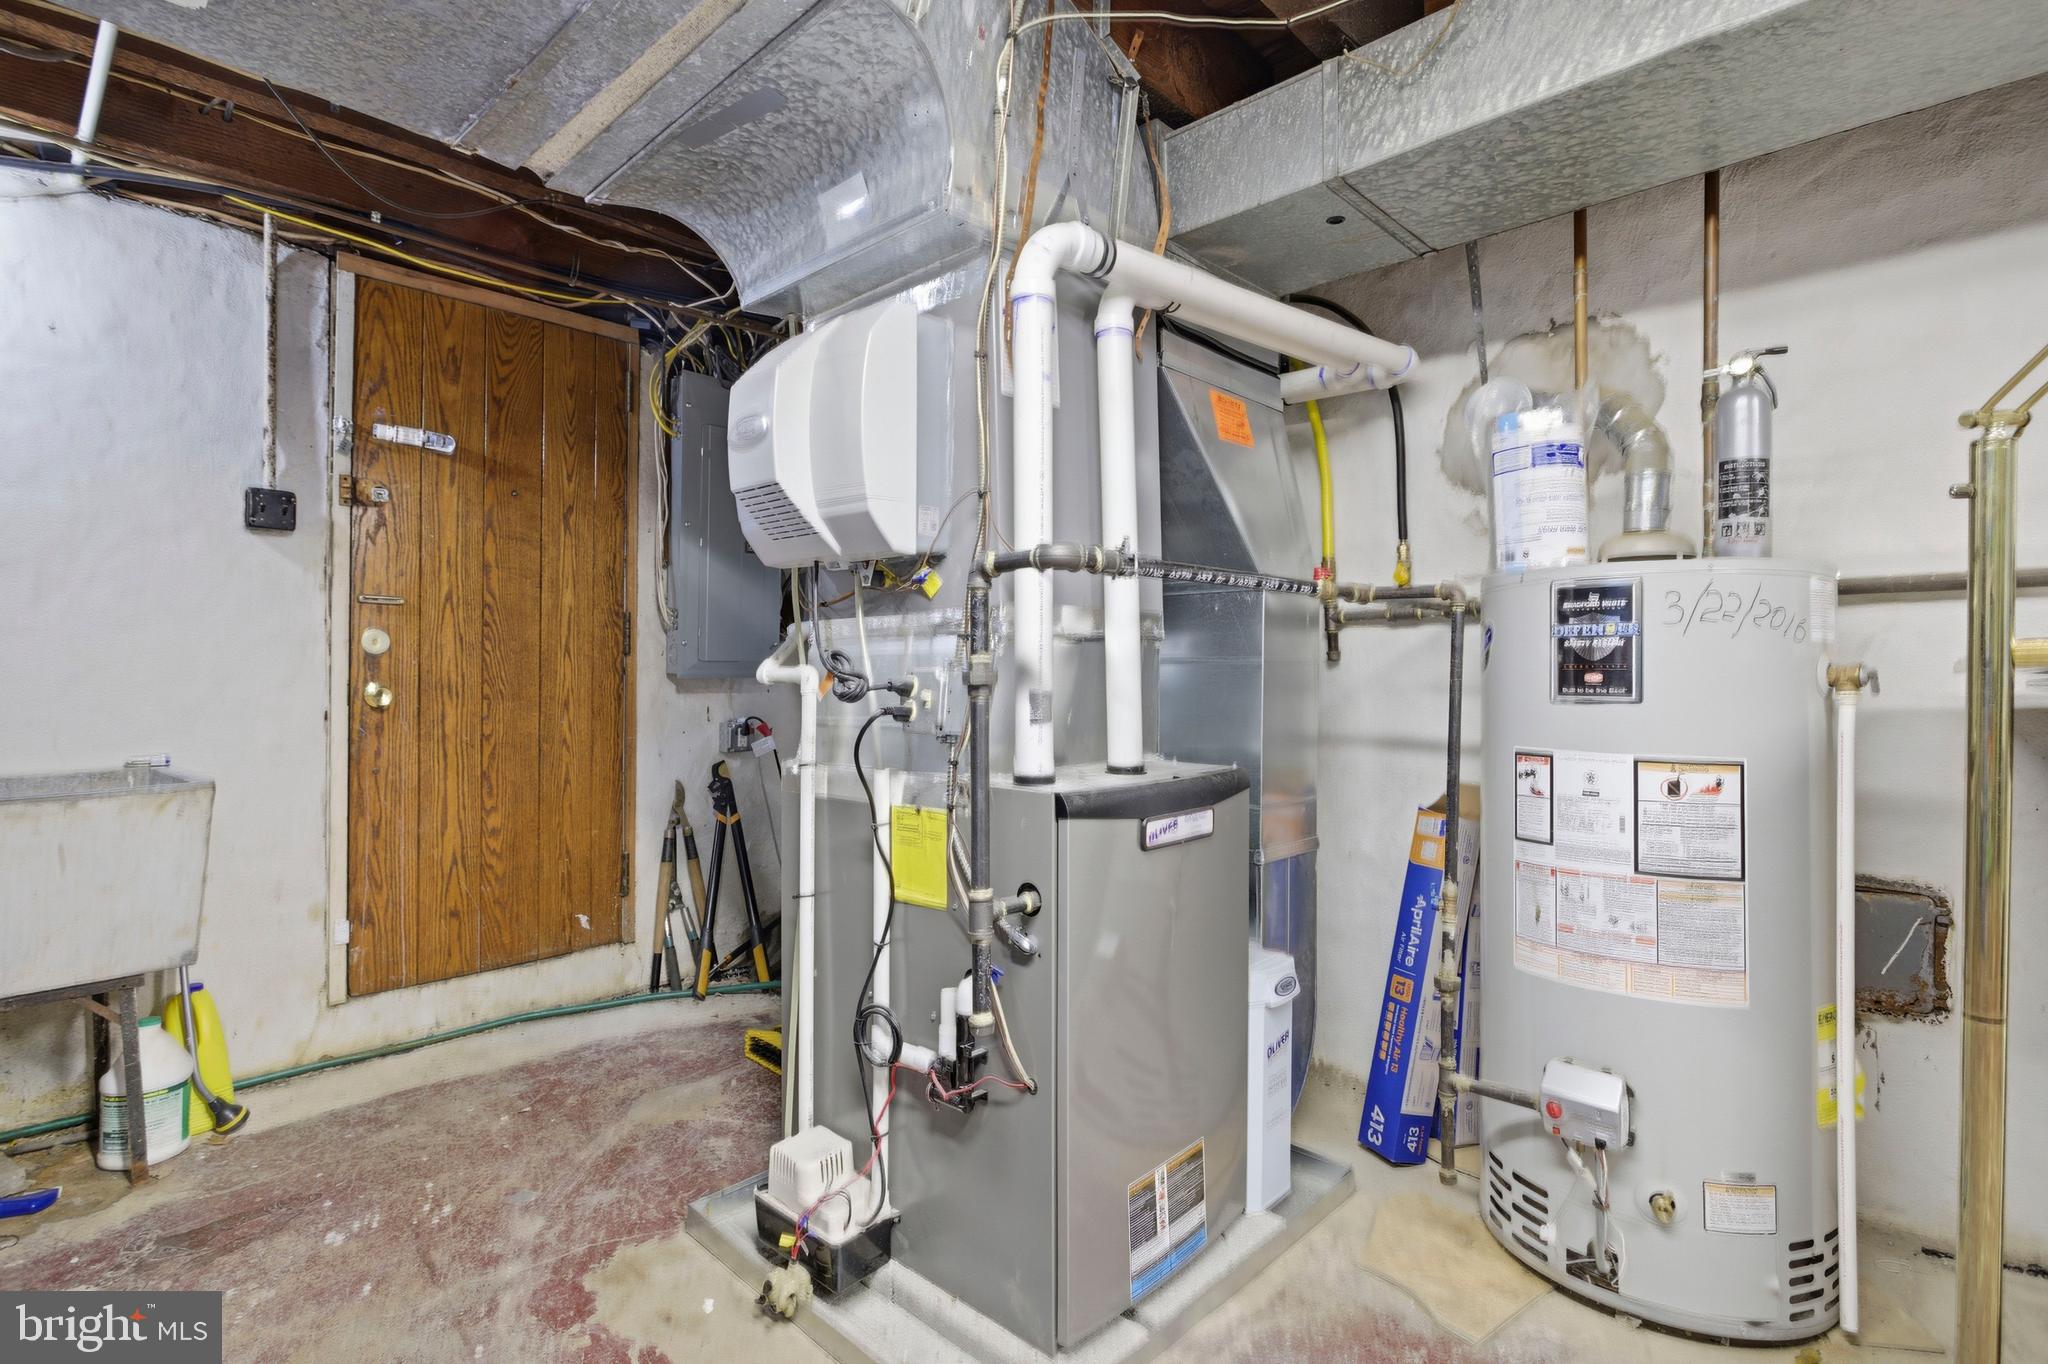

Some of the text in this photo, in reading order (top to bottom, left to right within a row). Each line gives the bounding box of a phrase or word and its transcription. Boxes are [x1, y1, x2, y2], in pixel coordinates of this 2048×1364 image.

[1661, 578, 1806, 643] 3/22/2016
[1405, 893, 1426, 967] AprilAire
[1394, 980, 1406, 996] 13
[1367, 1103, 1386, 1147] 413
[1406, 1126, 1420, 1154] 413
